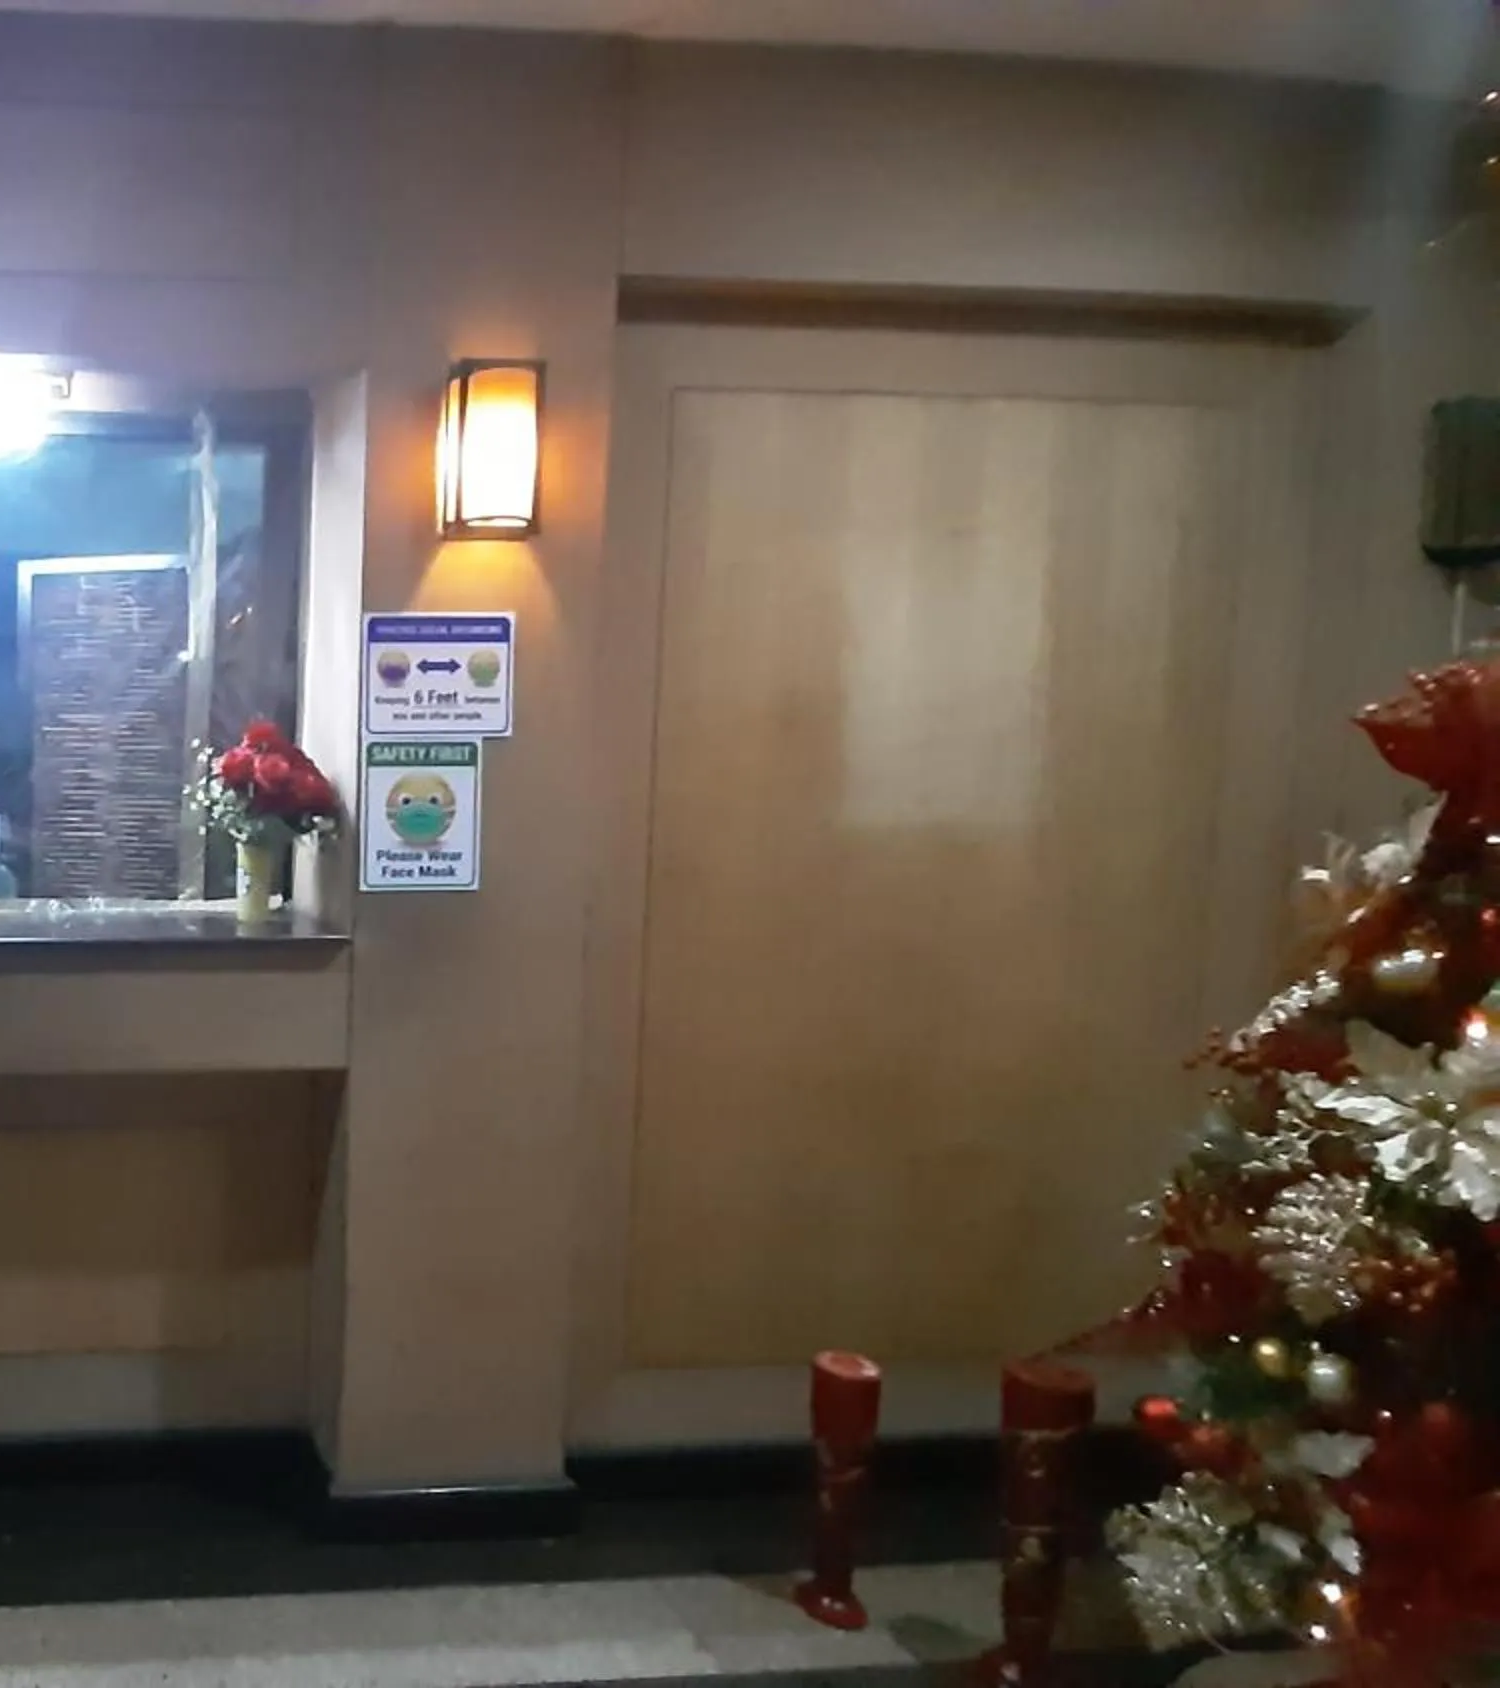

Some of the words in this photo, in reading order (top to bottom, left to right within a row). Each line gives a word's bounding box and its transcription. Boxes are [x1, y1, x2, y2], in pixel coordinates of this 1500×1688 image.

[413, 690, 424, 704] 6
[427, 689, 459, 705] Feet
[371, 744, 426, 761] SAFETY
[429, 744, 472, 761] FIRST
[376, 849, 423, 861] Please
[427, 850, 463, 861] Wear
[381, 865, 415, 878] Face
[418, 864, 457, 877] Mask
